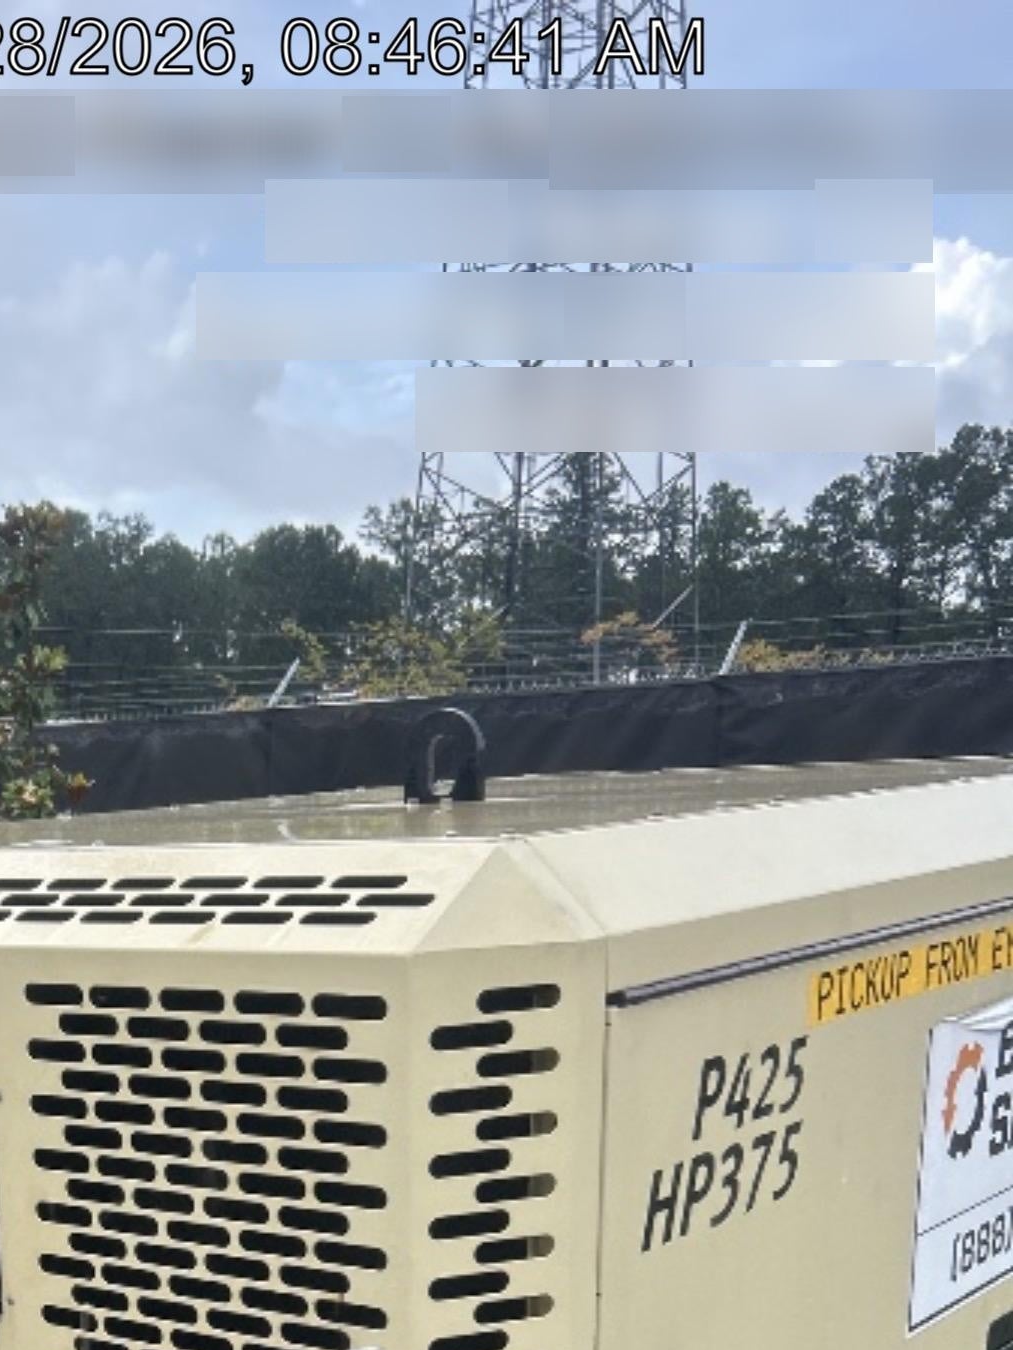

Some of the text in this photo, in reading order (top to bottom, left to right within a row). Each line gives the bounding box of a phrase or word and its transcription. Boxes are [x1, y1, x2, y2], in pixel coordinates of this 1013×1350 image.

[817, 950, 911, 1021] PICKUP
[925, 934, 981, 988] FROM
[692, 1035, 809, 1141] P425
[641, 1119, 803, 1254] HP375
